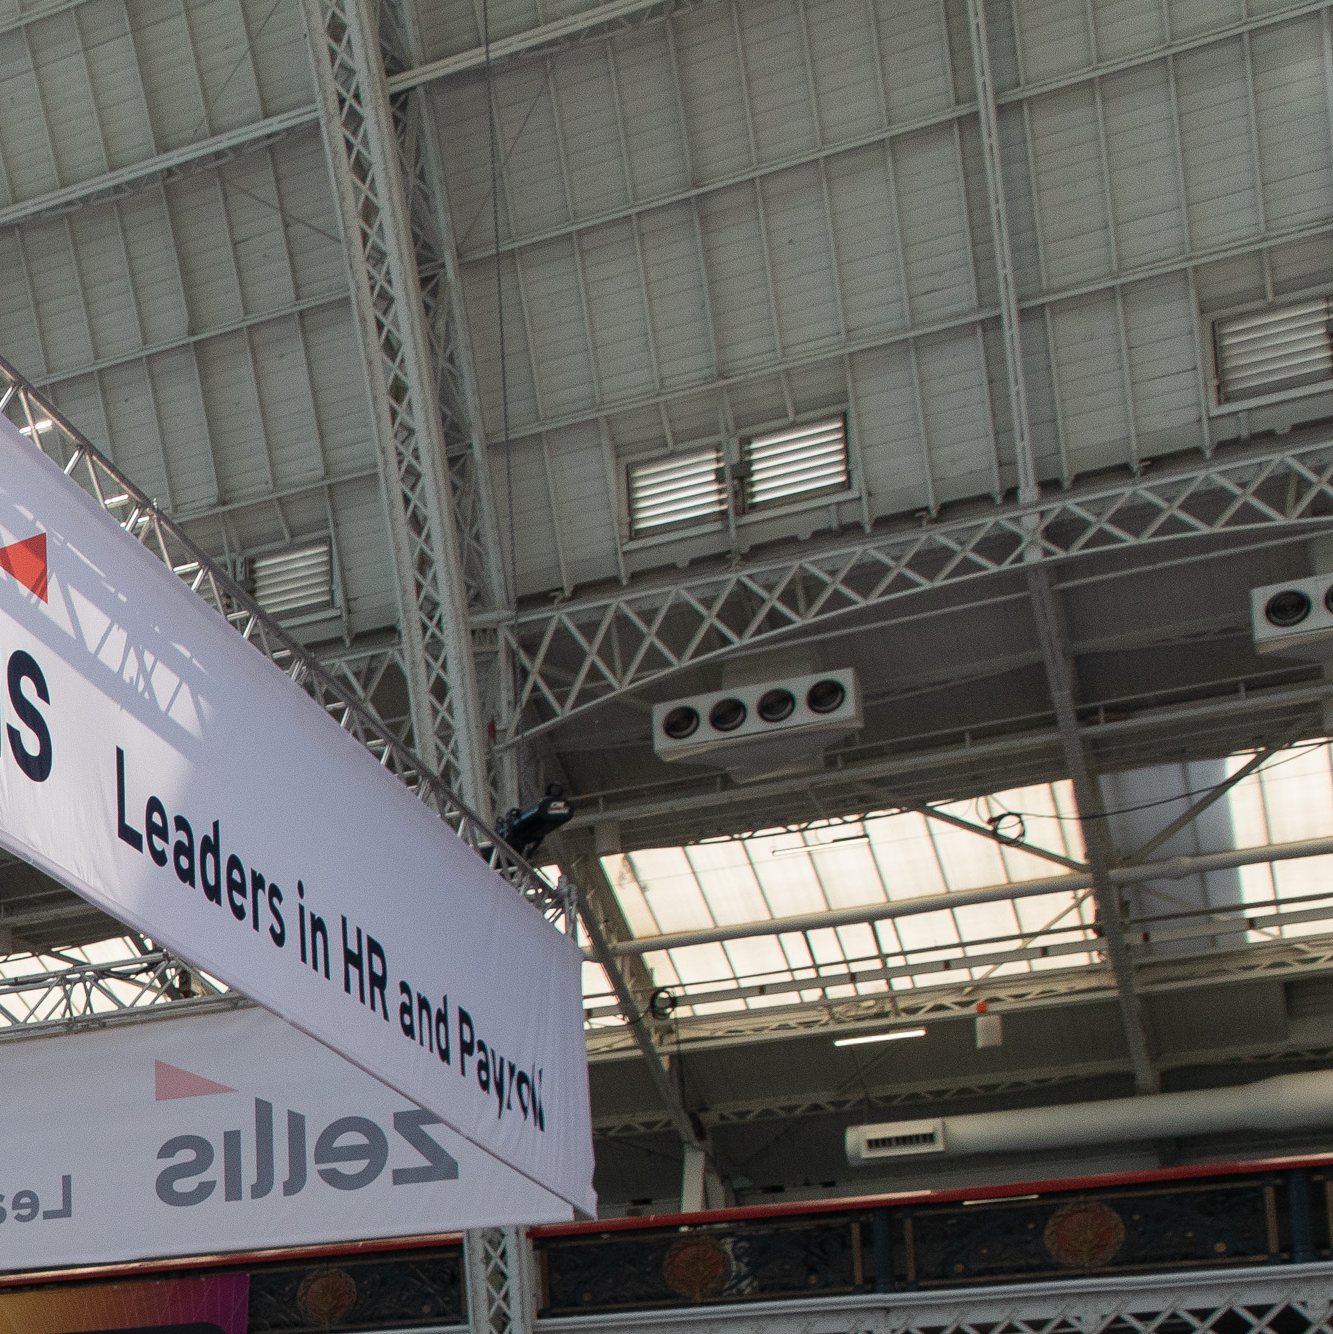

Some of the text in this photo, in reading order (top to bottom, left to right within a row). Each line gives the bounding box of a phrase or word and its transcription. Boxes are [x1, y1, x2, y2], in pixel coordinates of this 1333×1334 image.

[114, 745, 287, 949] Leaders
[296, 878, 332, 981] in
[340, 913, 390, 1023] HR
[397, 979, 452, 1066] and
